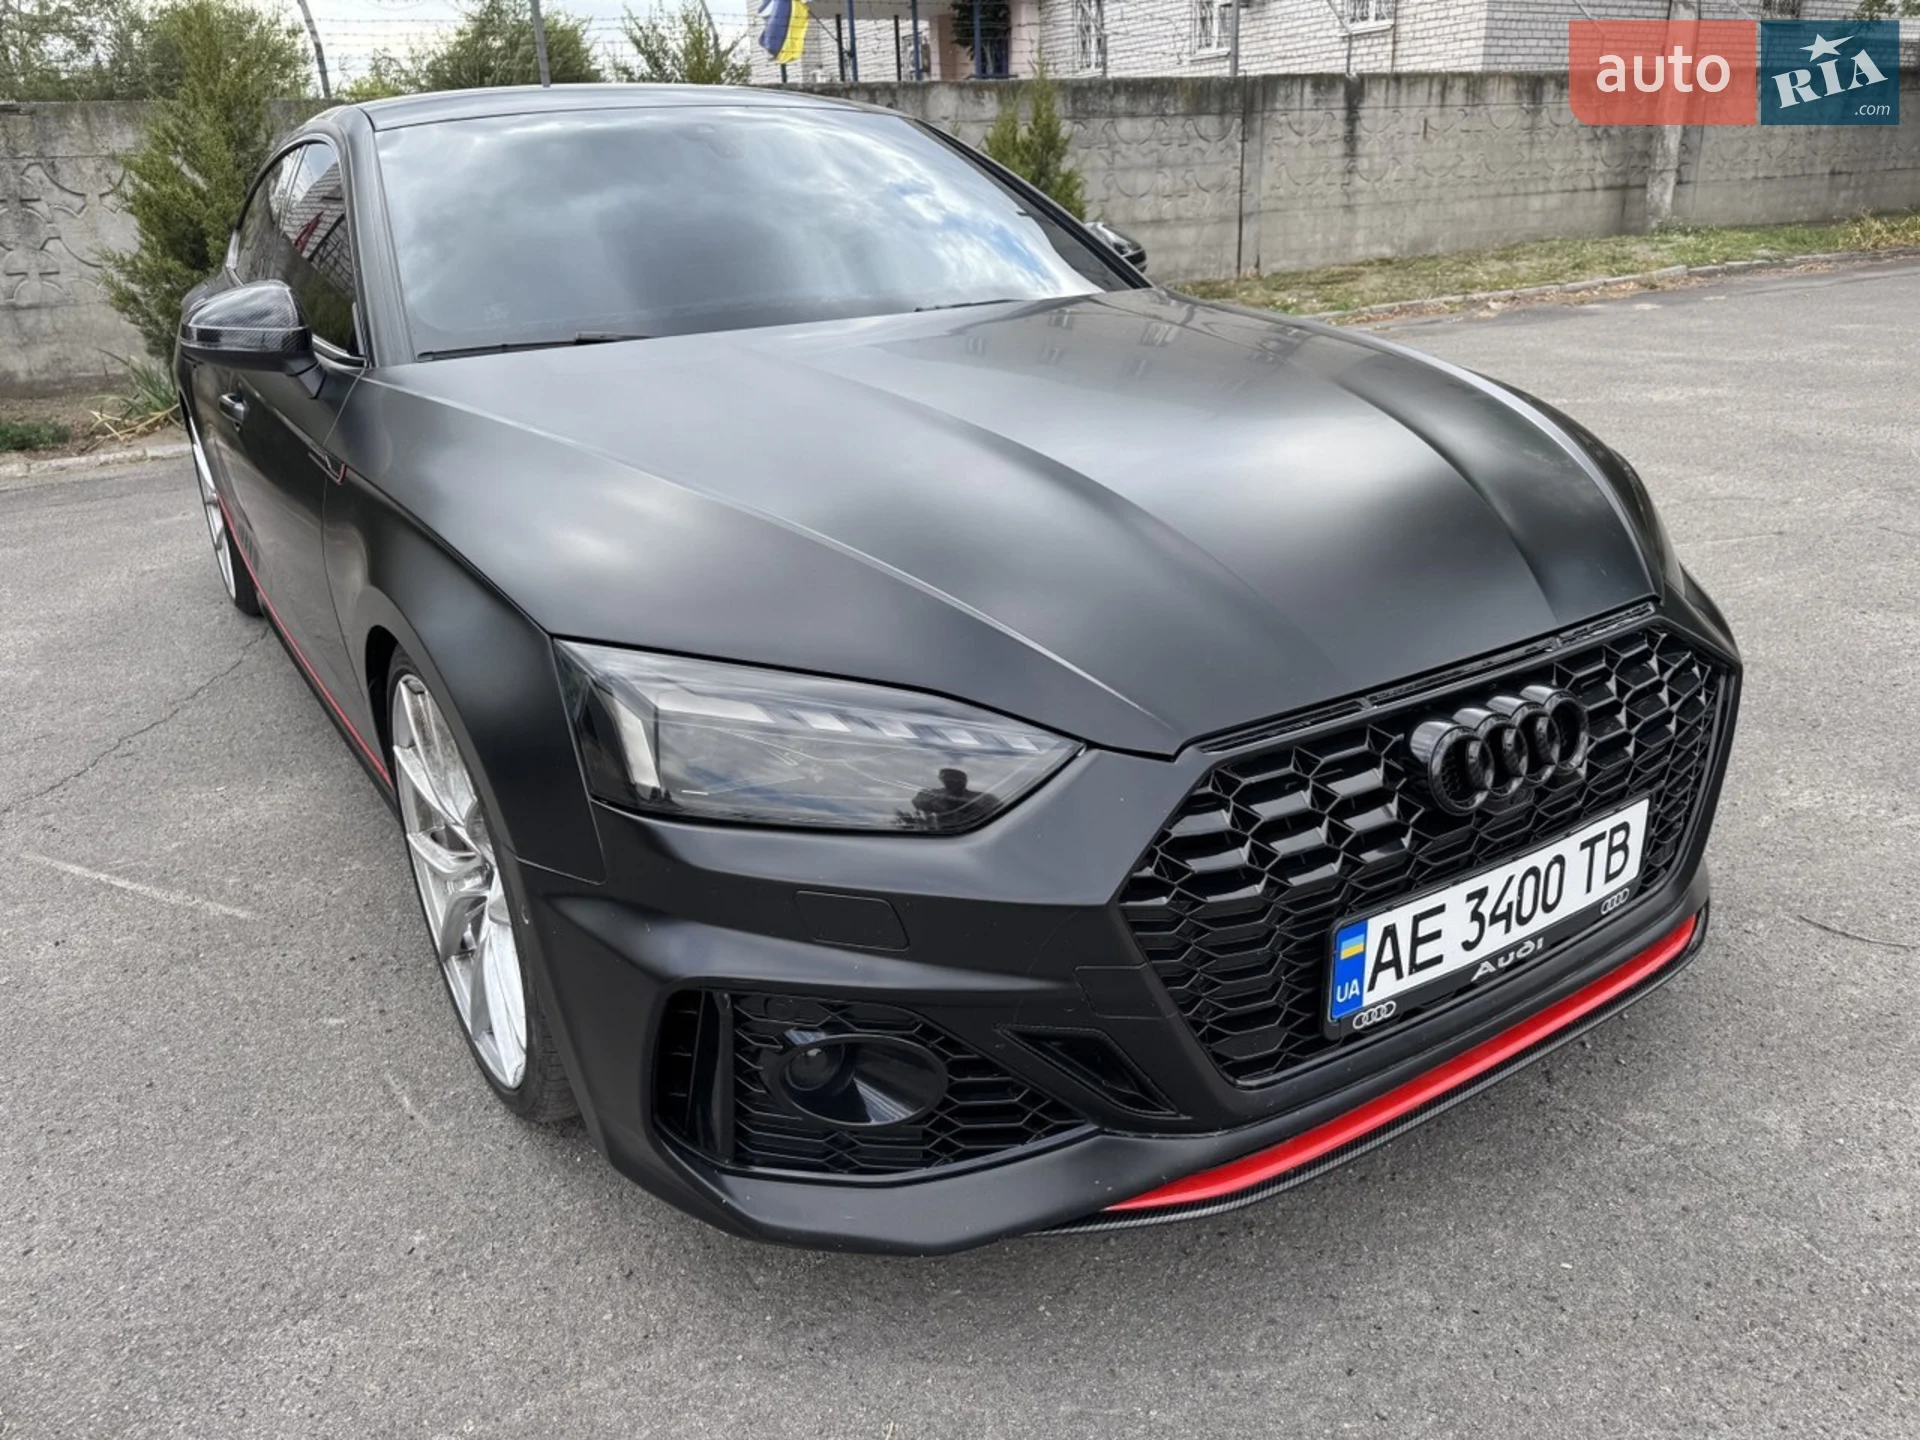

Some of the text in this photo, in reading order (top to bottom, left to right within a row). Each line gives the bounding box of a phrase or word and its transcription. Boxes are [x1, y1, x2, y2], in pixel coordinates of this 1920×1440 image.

[1367, 821, 1631, 992] AE 3400 TB
[1337, 978, 1360, 1003] UA
